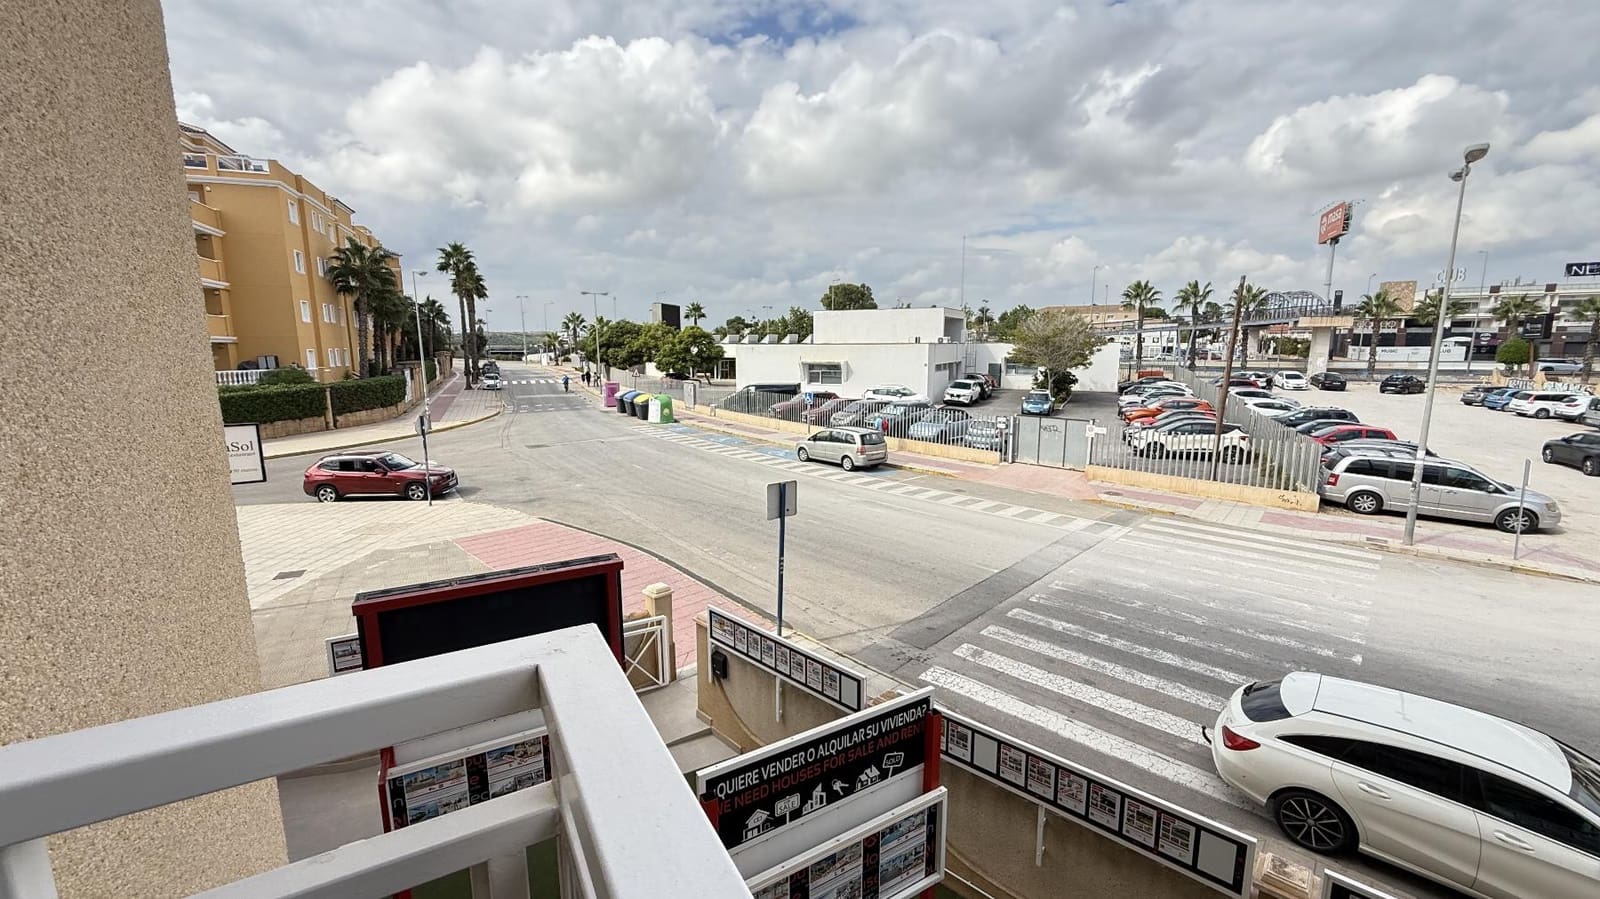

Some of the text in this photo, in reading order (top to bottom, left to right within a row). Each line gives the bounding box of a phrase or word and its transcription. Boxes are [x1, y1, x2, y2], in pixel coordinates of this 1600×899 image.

[734, 784, 769, 809] NEED
[772, 762, 821, 793] HOUSES
[823, 754, 846, 772] FOR
[847, 740, 875, 762] SALE
[876, 731, 899, 750] AND
[761, 751, 805, 780] VENDER
[806, 748, 816, 762] O
[817, 727, 866, 759] ALQUILAR
[866, 722, 879, 739] SU
[880, 704, 927, 733] VIVIENDA?
[778, 800, 797, 813] SALE
